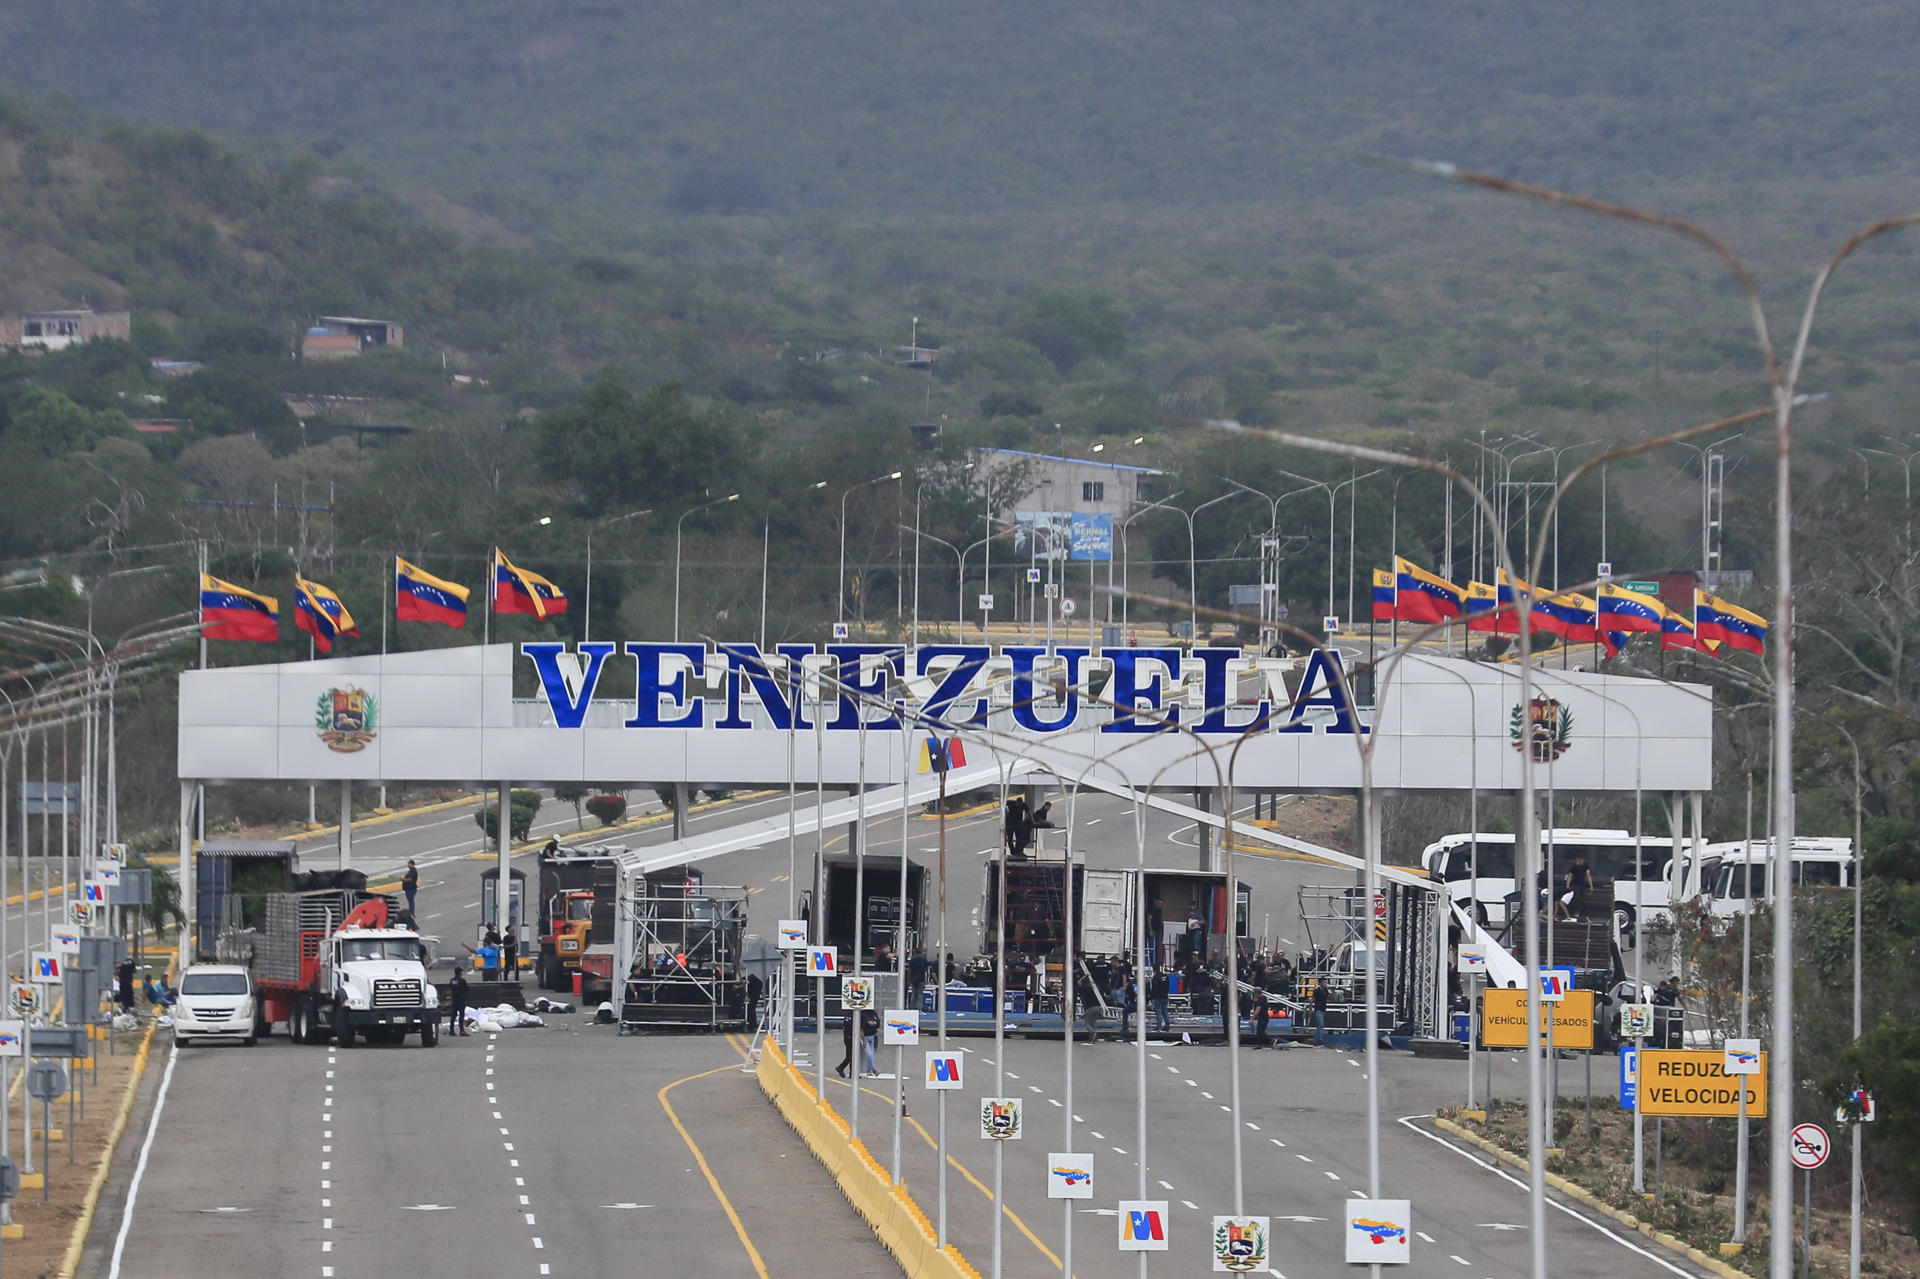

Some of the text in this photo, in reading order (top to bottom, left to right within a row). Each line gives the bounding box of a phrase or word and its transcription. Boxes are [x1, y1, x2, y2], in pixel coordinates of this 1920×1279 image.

[521, 642, 1371, 735] VENEZUELA
[1488, 1015, 1529, 1025] VEHÍCUL
[1658, 1062, 1740, 1077] REDUZ
[1650, 1088, 1756, 1104] VELOCIDAD
